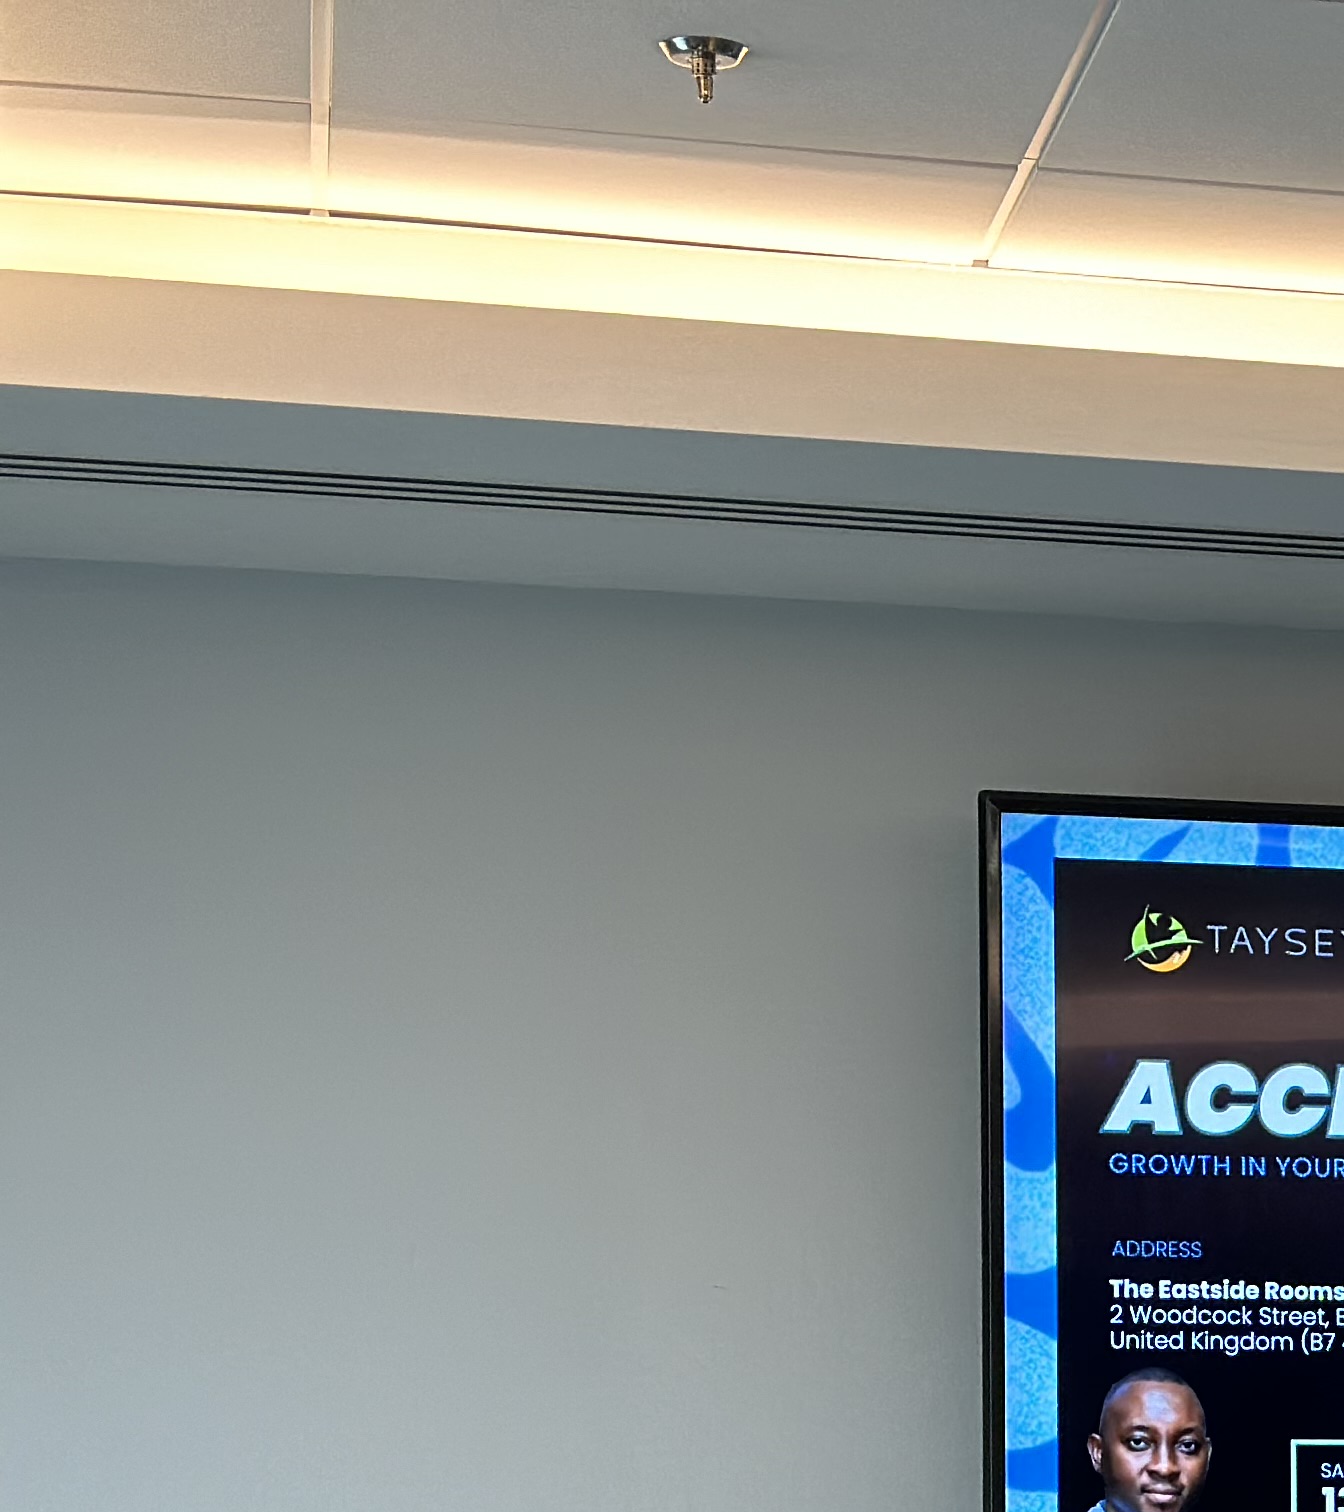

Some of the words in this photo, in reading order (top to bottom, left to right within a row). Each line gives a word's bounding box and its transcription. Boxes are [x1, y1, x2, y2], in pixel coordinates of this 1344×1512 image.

[1108, 1152, 1231, 1177] GROWTH
[1241, 1156, 1267, 1178] IN
[1111, 1240, 1203, 1259] ADDRESS
[1108, 1278, 1155, 1300] The
[1158, 1278, 1260, 1300] Eastside
[1109, 1304, 1124, 1324] 2
[1129, 1305, 1253, 1326] Woodcock
[1258, 1307, 1330, 1329] Street,
[1110, 1329, 1184, 1350] United
[1191, 1330, 1294, 1357] Kingdom
[1300, 1327, 1336, 1356] (B7
